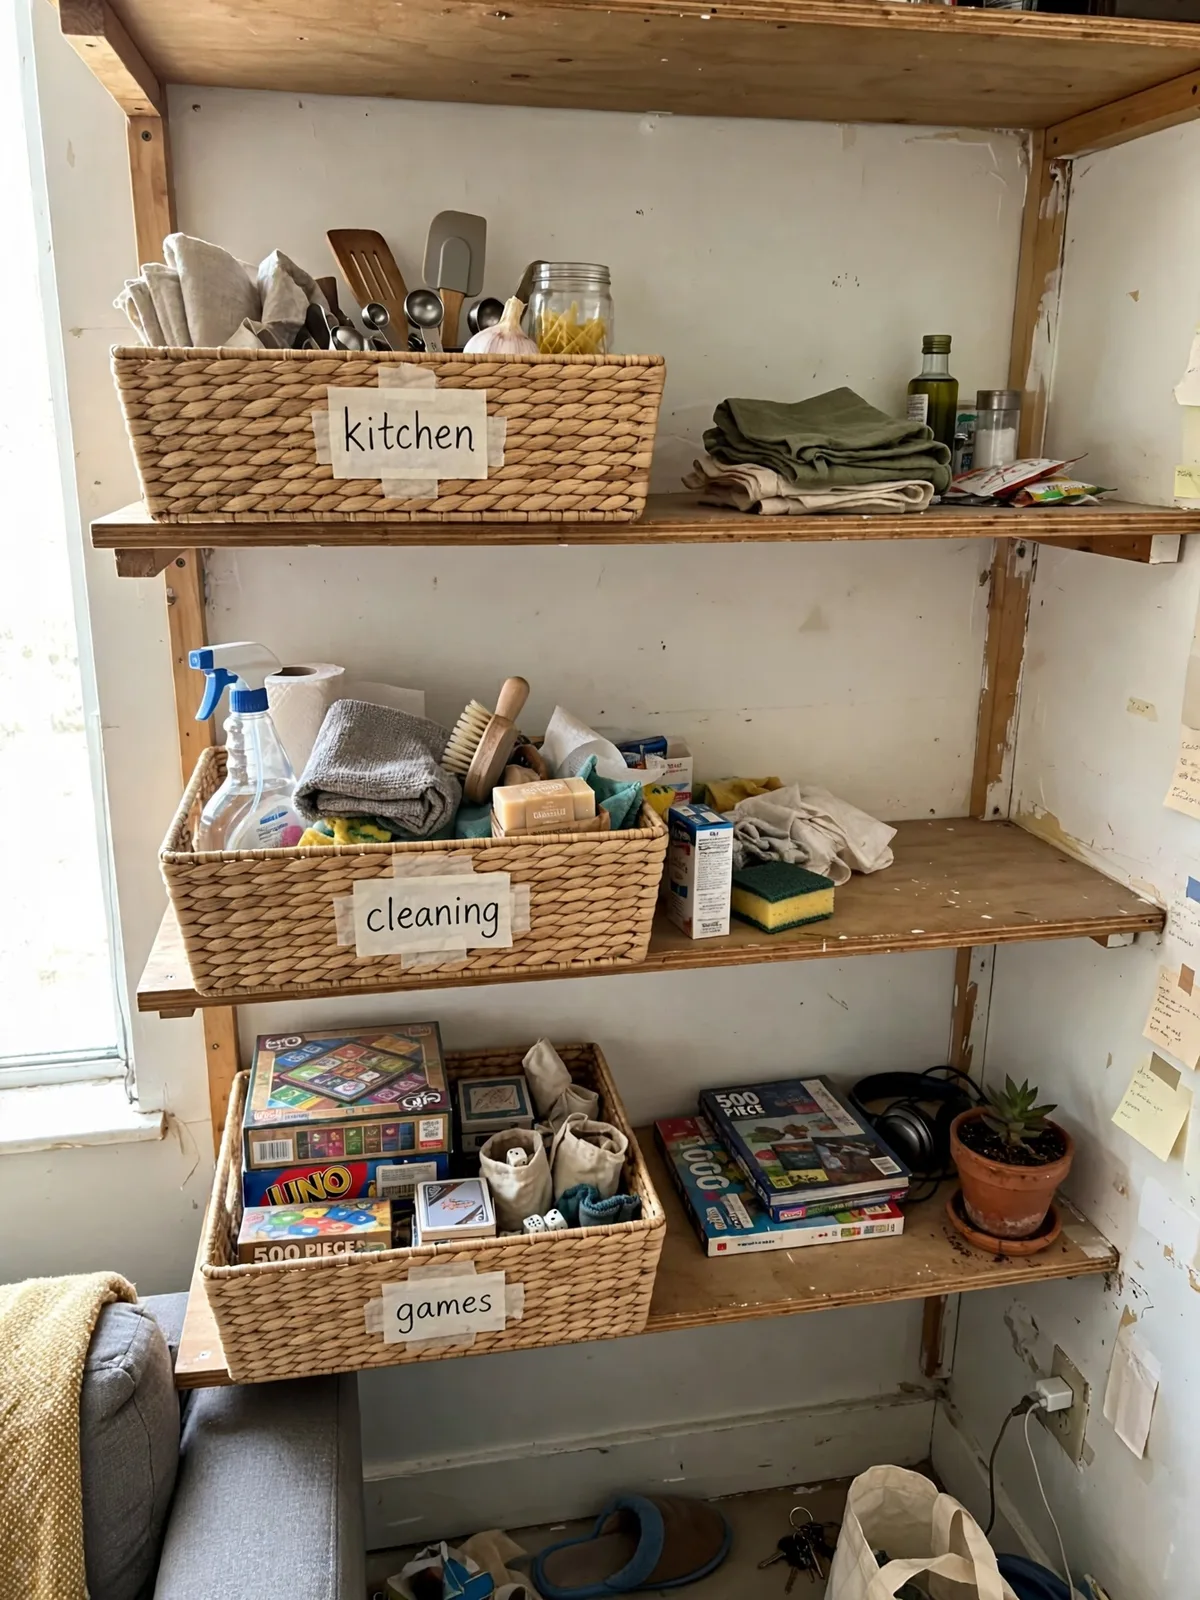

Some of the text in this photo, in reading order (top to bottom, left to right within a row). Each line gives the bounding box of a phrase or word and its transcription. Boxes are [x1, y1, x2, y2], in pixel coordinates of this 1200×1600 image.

[344, 405, 475, 452] kitchen
[366, 896, 499, 939] cleaning
[714, 1091, 760, 1108] 500
[723, 1104, 766, 1118] PIECE
[266, 1164, 352, 1206] UNO
[253, 1244, 301, 1264] 500
[396, 1293, 492, 1334] games
